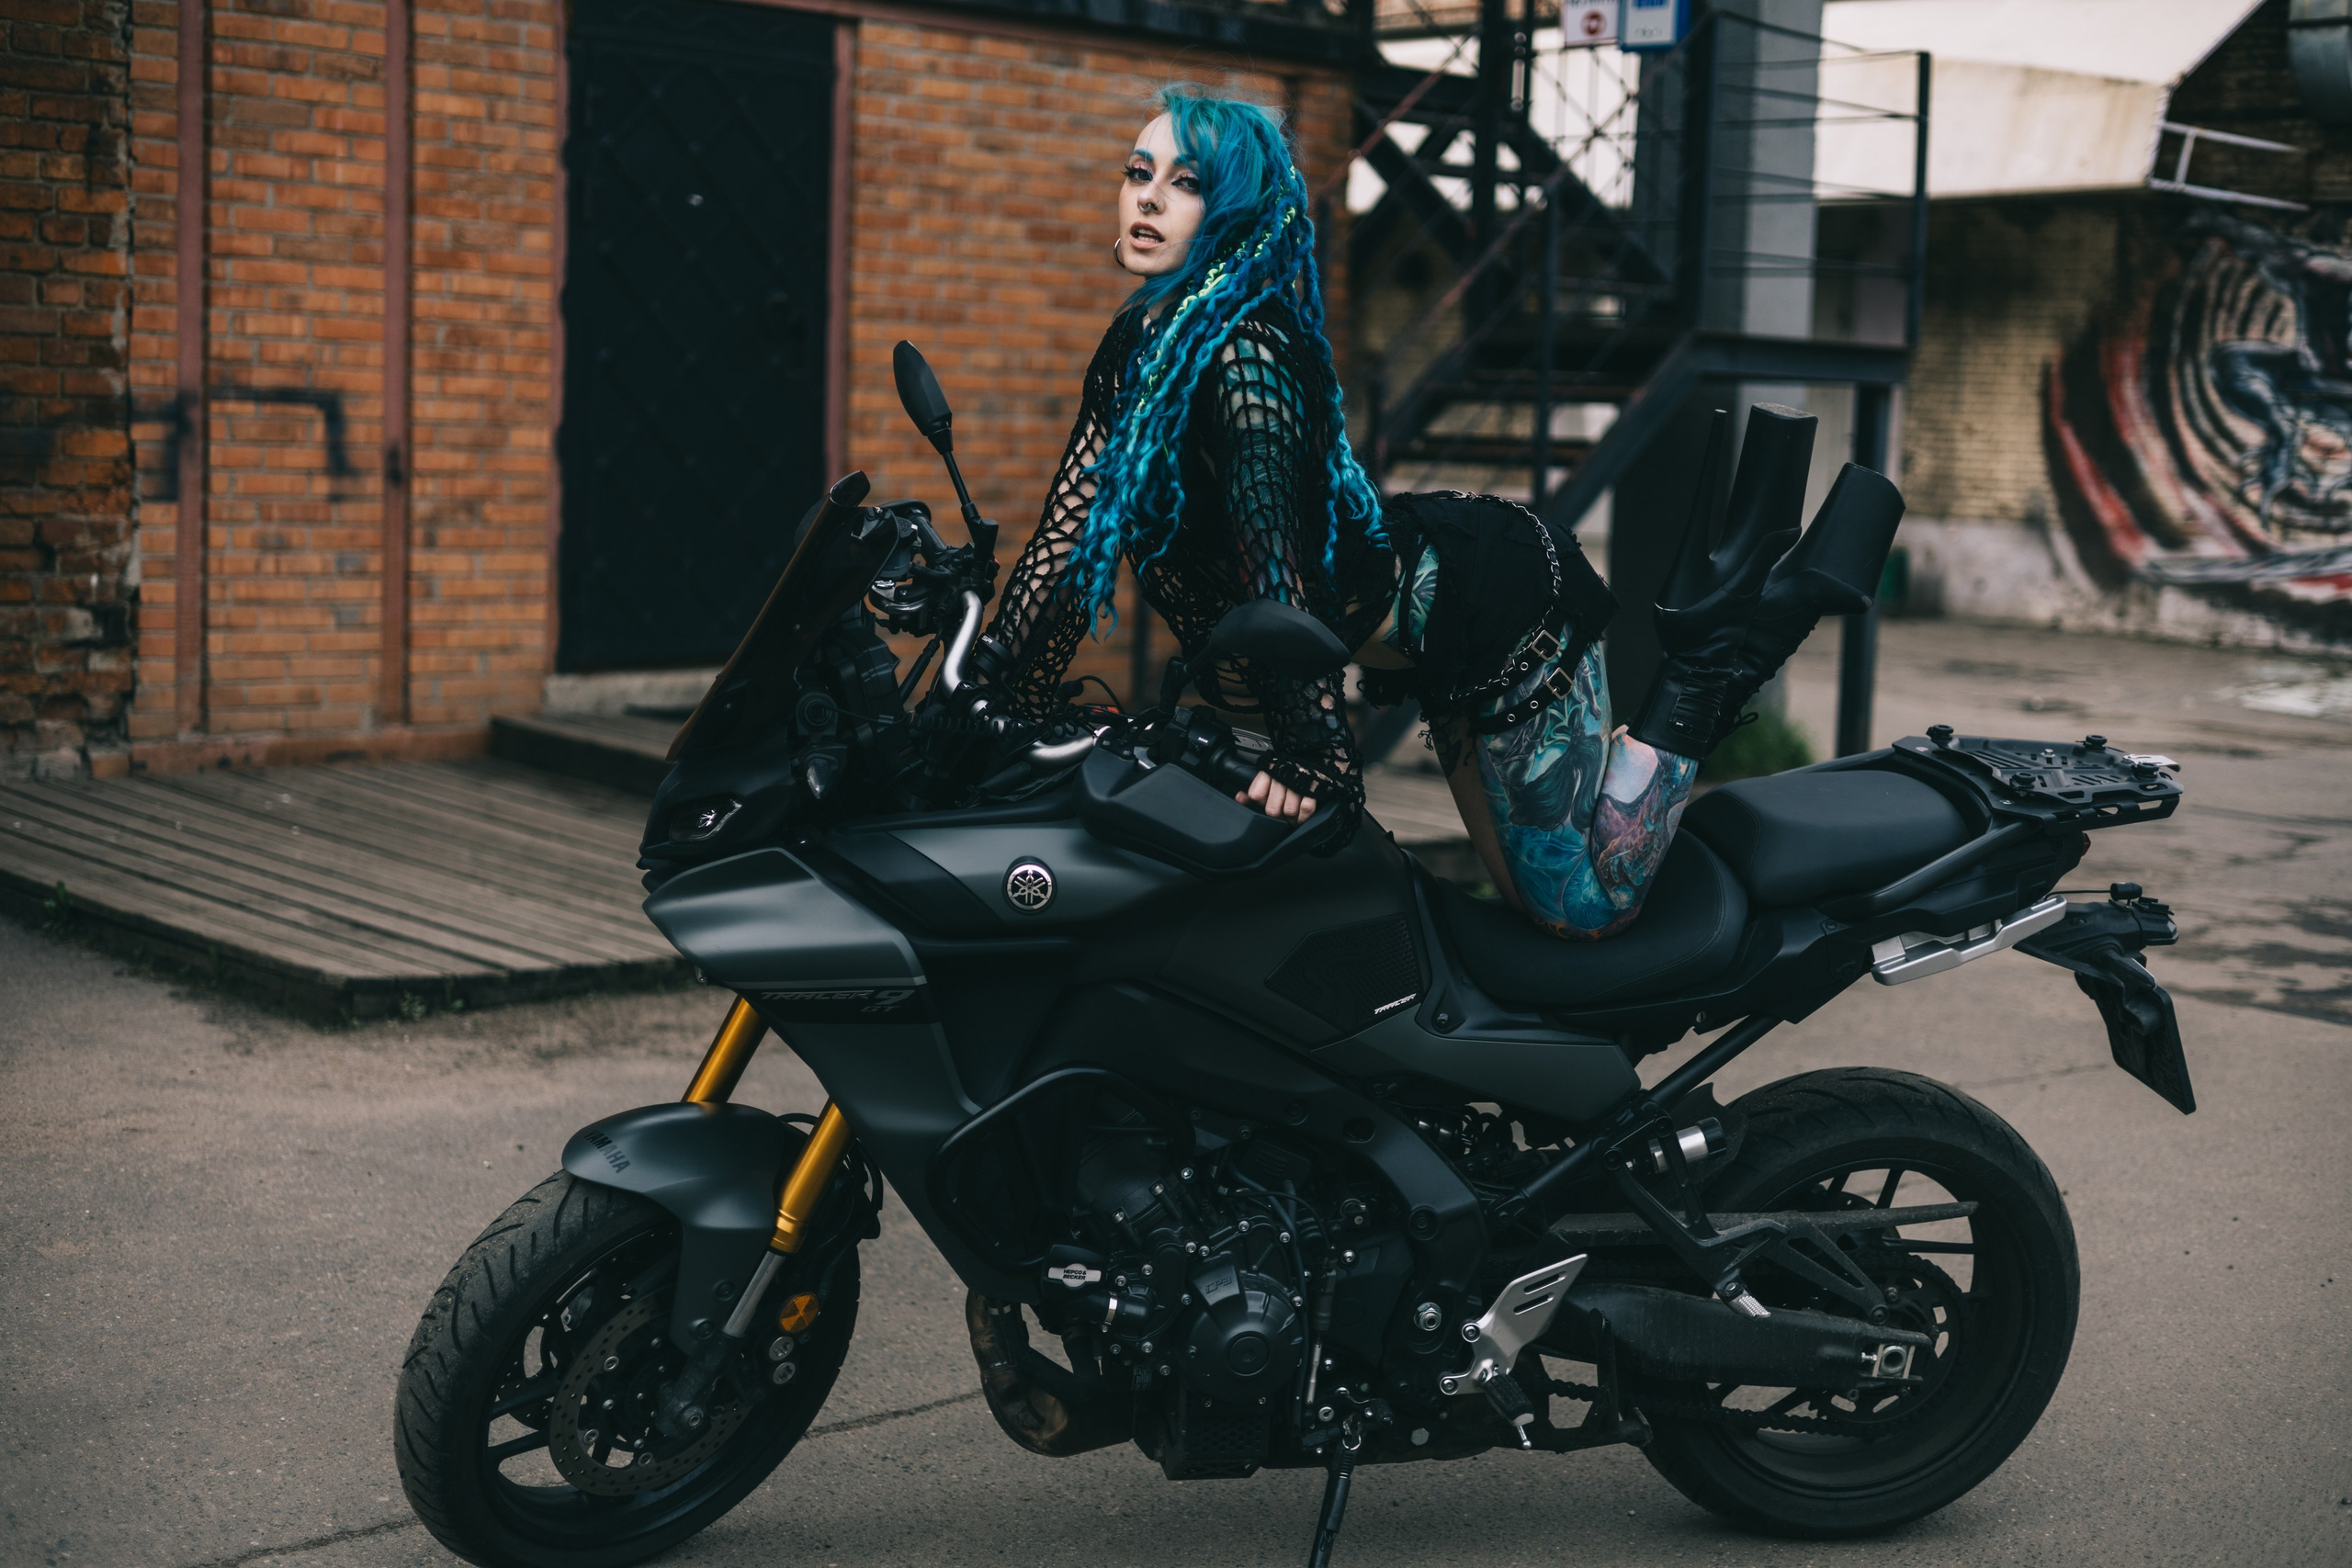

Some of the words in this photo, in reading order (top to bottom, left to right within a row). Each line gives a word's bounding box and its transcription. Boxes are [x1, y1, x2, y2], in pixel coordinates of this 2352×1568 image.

[761, 989, 876, 1000] TRACER
[874, 989, 916, 1005] 9
[583, 1129, 631, 1174] YAMAHA
